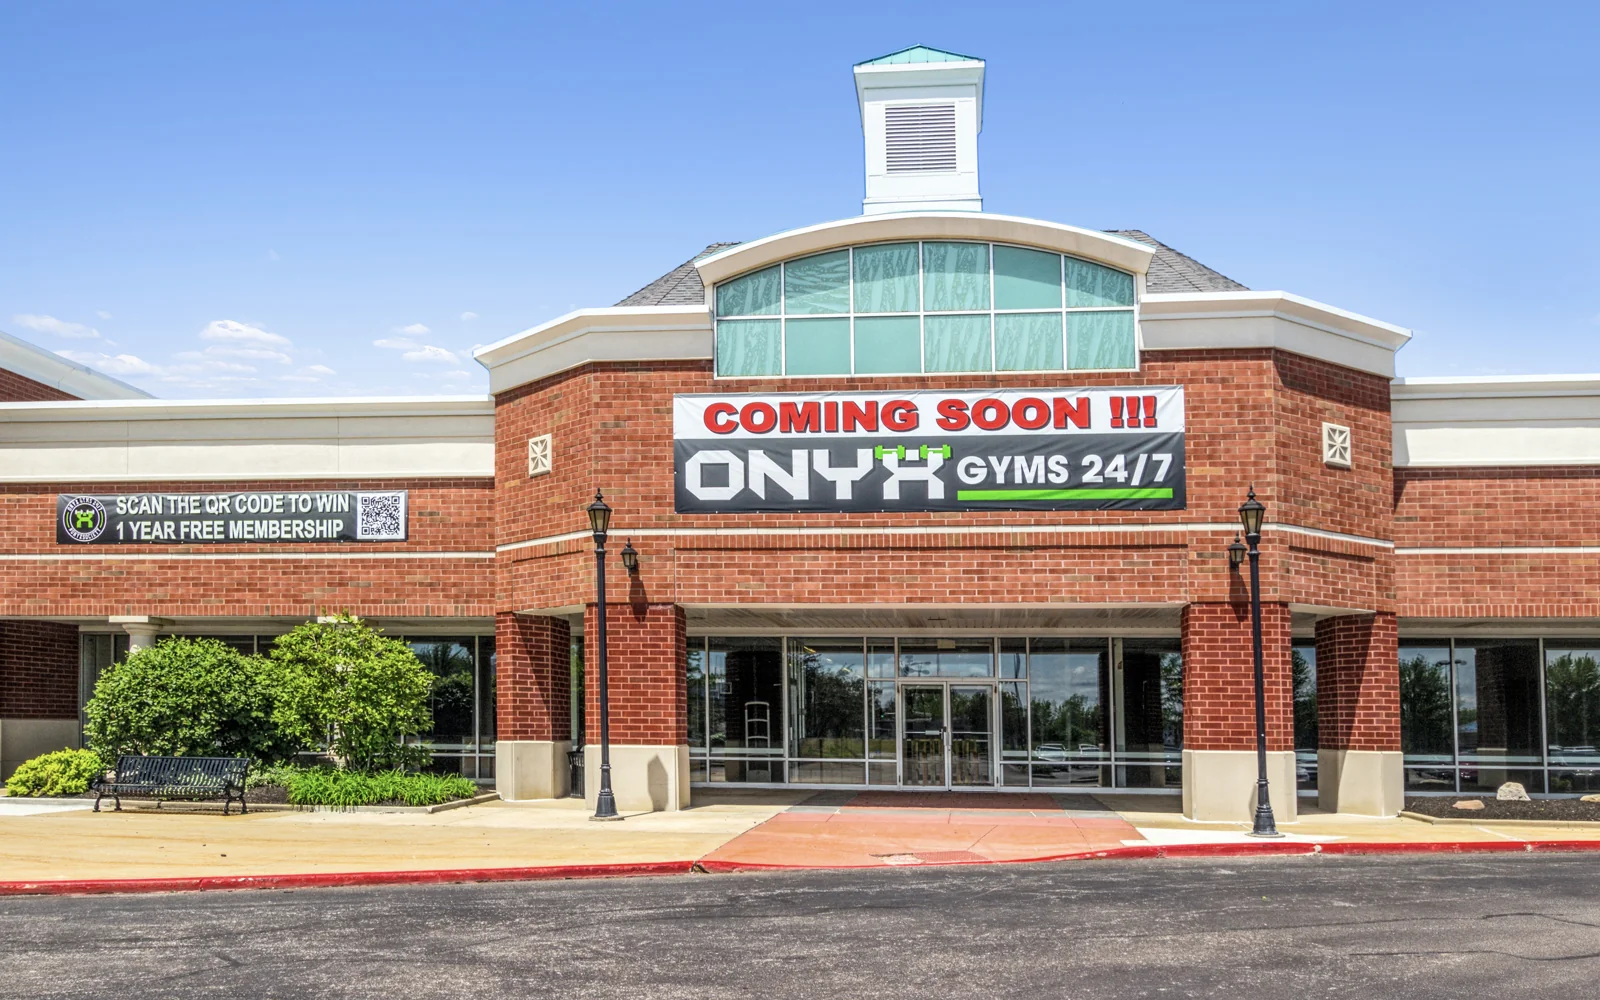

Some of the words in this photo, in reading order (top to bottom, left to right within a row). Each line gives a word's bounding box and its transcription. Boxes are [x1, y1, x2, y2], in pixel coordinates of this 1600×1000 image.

[703, 400, 919, 434] COMING
[936, 397, 1091, 431] SOON
[1109, 395, 1158, 428] !!!
[685, 446, 946, 500] ONYX
[957, 455, 1069, 485] GYMS
[1081, 453, 1173, 486] 24/7
[116, 496, 163, 514] SCAN
[167, 495, 201, 514] THE
[205, 495, 231, 515] QR
[235, 494, 284, 513] CODE
[288, 494, 312, 513] TO
[315, 493, 349, 513] WIN
[116, 521, 124, 539] 1
[129, 521, 176, 539] YEAR
[180, 520, 225, 539] FREE
[229, 519, 344, 539] MEMBERSHIP
